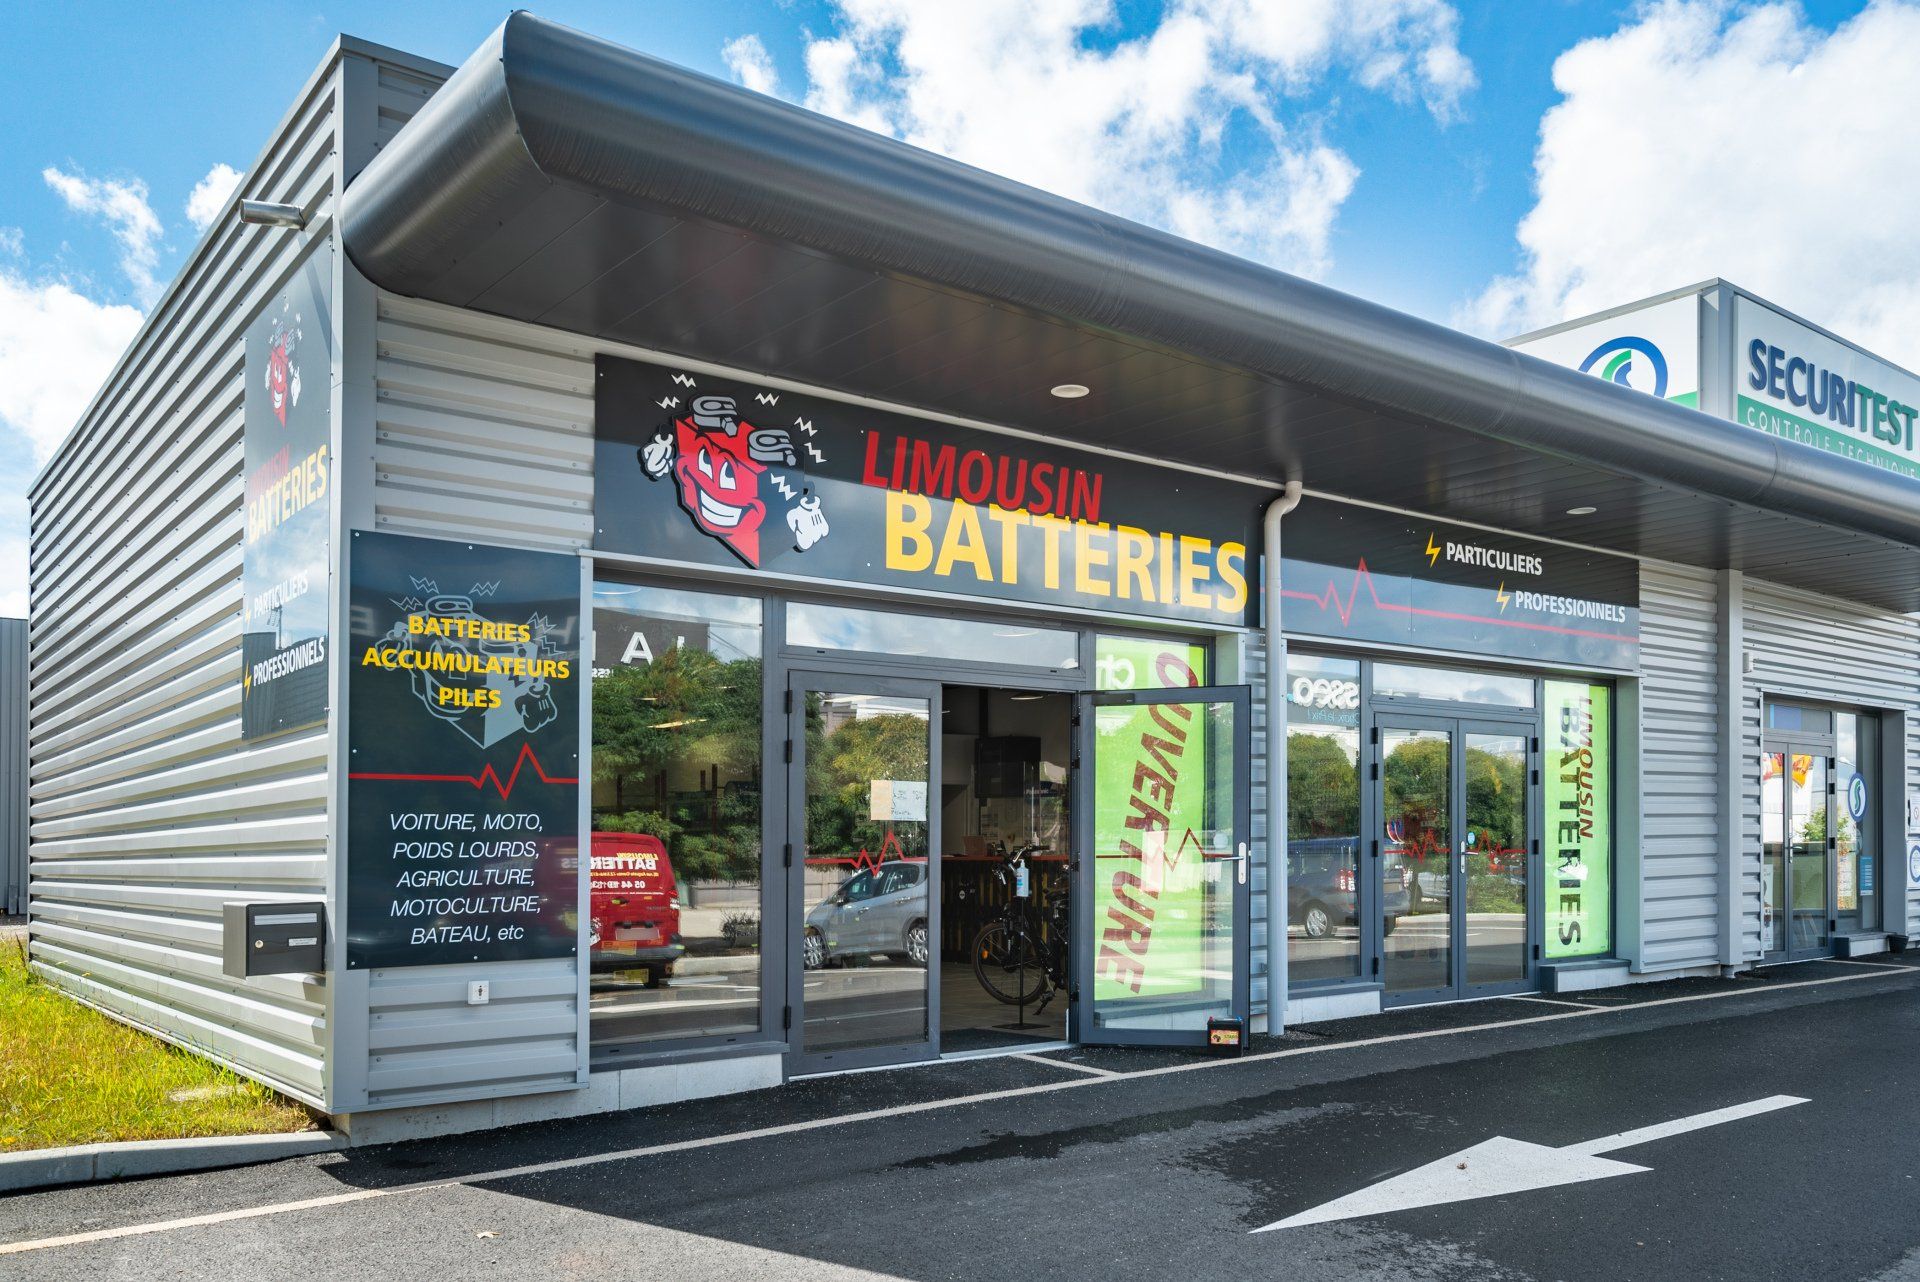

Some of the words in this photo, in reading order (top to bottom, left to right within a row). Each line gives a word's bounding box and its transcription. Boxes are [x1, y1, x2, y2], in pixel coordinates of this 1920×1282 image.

[1748, 338, 1919, 451] SECURITEST
[862, 430, 1103, 523] LIMOUSIN
[247, 444, 328, 544] BATTERIES
[885, 489, 1248, 614] BATTERIES
[1446, 542, 1543, 576] PARTICULIERS
[253, 569, 309, 619] PARTICULIERS
[1515, 590, 1626, 623] PROFESSIONNELS
[408, 615, 531, 643] BATTERIES
[253, 636, 325, 686] PROFESSIONNELS
[362, 646, 570, 679] ACCUMULATEURS
[439, 686, 501, 709] PILES
[1577, 696, 1594, 839] LIMOUSIN
[390, 813, 477, 834] VOITURE,
[483, 813, 544, 833] MOTO,
[1096, 651, 1199, 994] OUVERTURE
[1558, 707, 1581, 946] BATTERIES
[393, 842, 454, 860] POIDS
[459, 841, 540, 860] LOURDS,
[397, 869, 536, 888] AGRICULTURE,
[390, 896, 541, 917] MOTOCULTURE,
[411, 926, 491, 945] BATEAU,
[498, 926, 525, 941] etc
